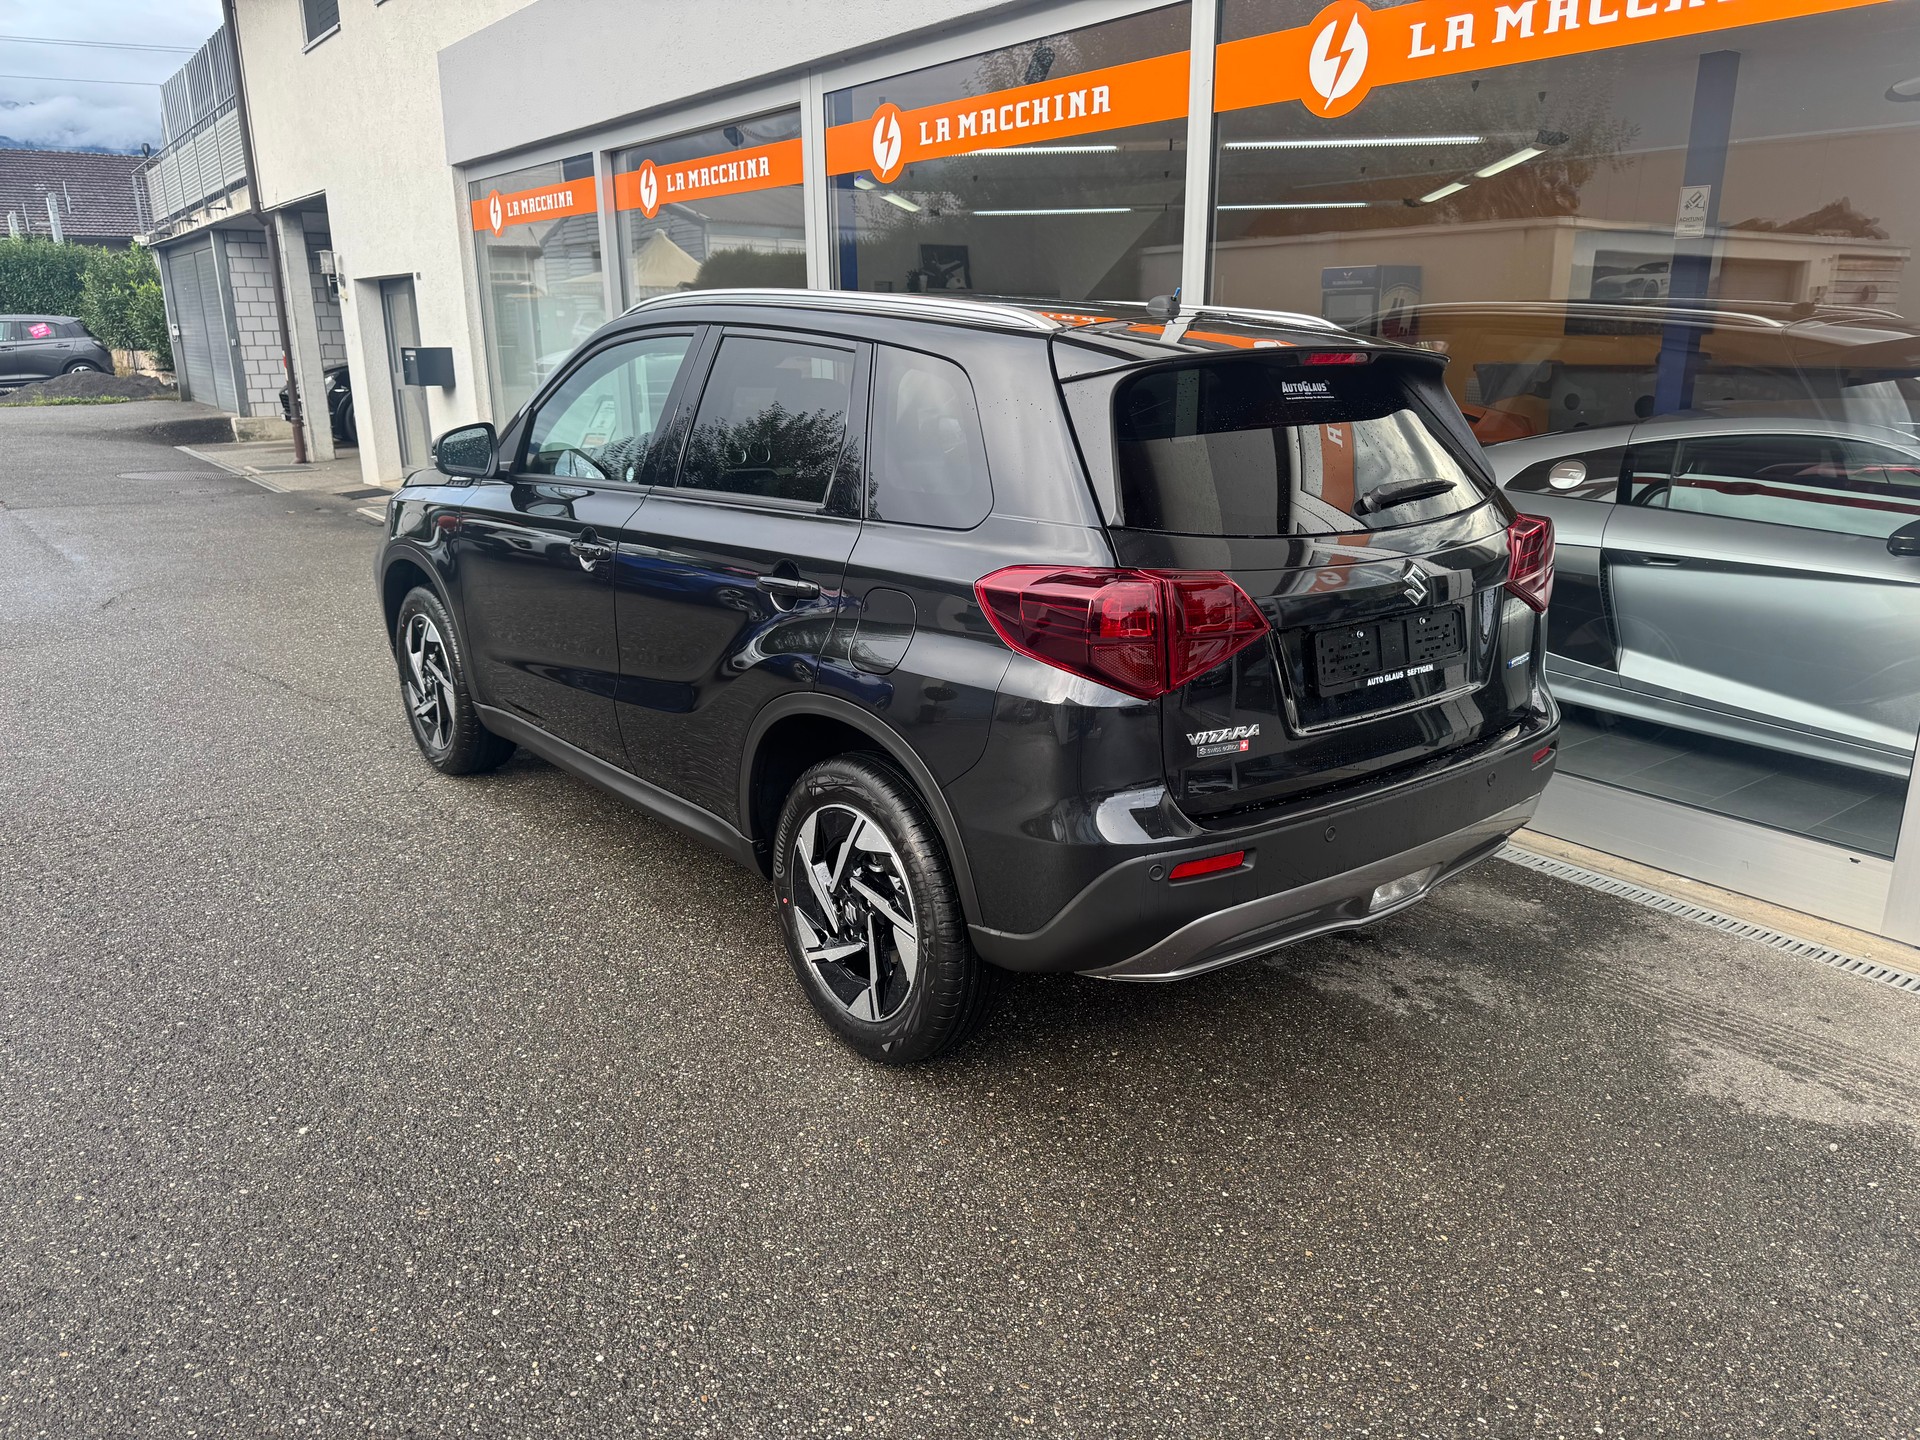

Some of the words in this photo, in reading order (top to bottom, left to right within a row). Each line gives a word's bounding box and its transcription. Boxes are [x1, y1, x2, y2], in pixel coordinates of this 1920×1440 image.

[1407, 13, 1475, 59] LA
[1491, 0, 1729, 43] MAC
[919, 117, 951, 146] LA
[957, 85, 1111, 139] MACCHINA
[666, 172, 685, 192] LA
[687, 156, 770, 189] MACCHINA
[507, 201, 520, 217] LA
[520, 190, 574, 214] MACCHINA
[1367, 675, 1384, 686] AUTO
[1384, 670, 1404, 682] GLAUS
[1406, 663, 1434, 677] SEFTIGEN
[1186, 723, 1260, 746] VITARA
